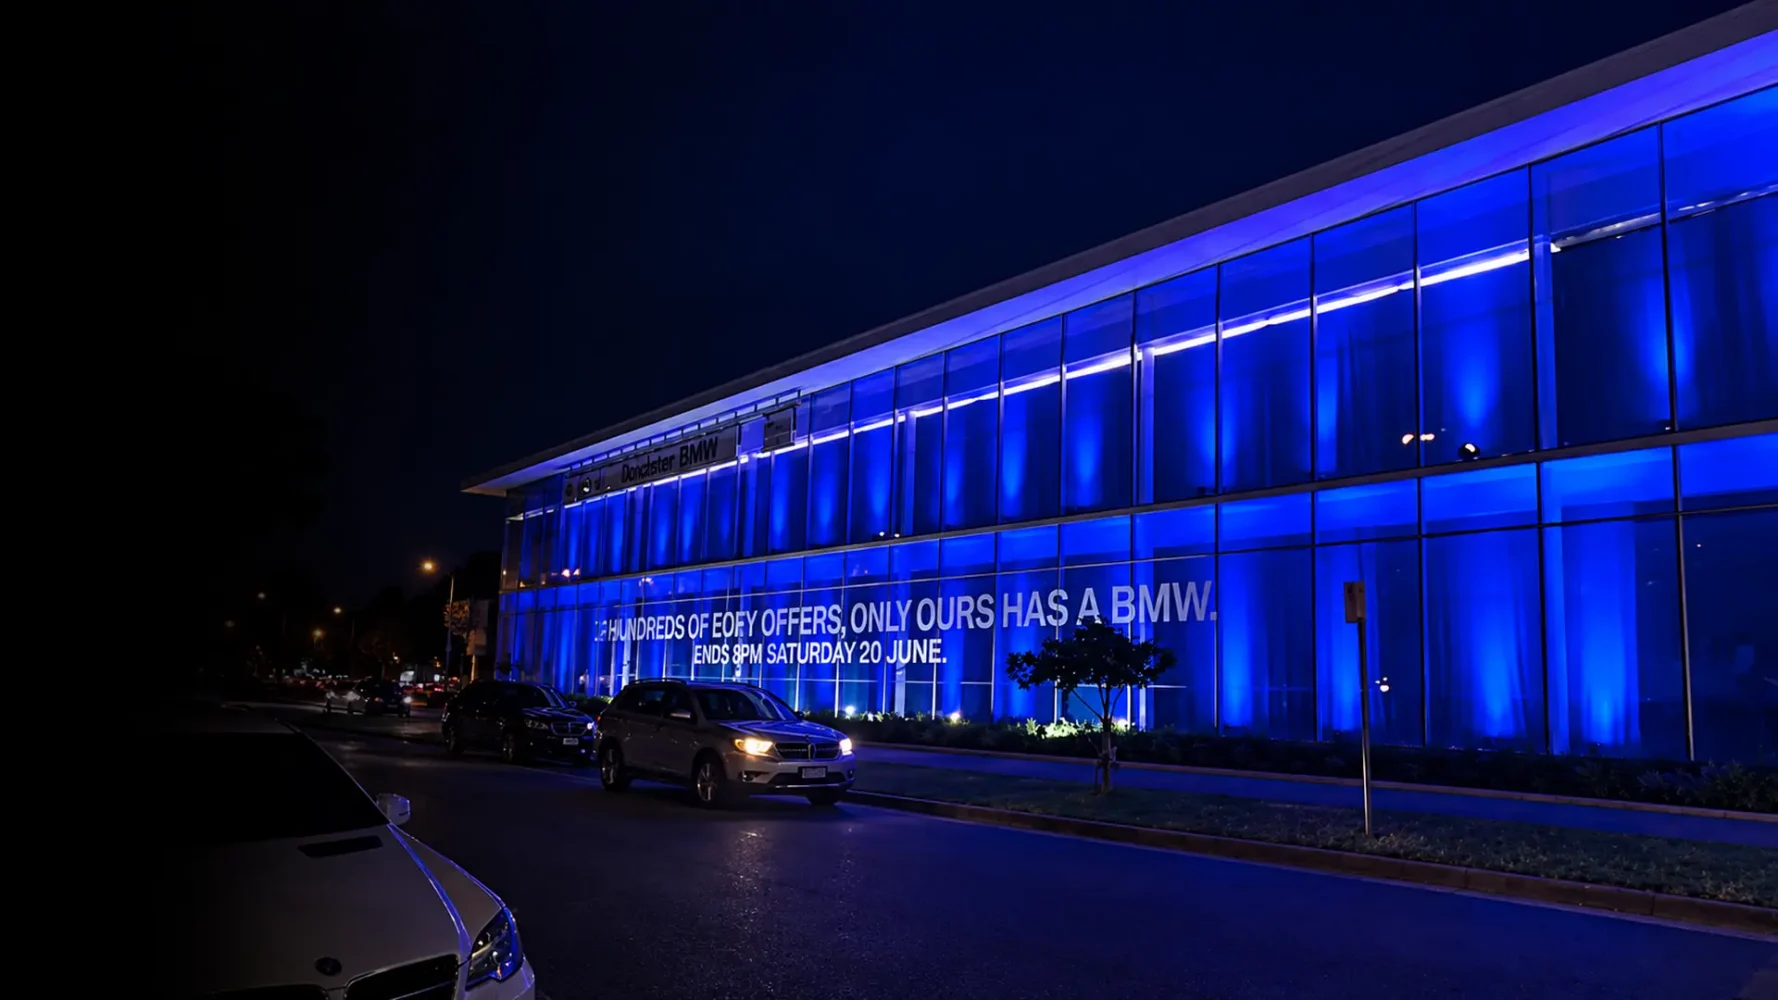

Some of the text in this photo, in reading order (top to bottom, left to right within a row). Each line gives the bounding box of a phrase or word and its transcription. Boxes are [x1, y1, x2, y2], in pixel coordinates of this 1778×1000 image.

[680, 437, 718, 466] BMW
[608, 615, 684, 641] HUNDREDS
[688, 614, 709, 639] OF
[712, 611, 757, 637] EOFY
[762, 606, 845, 637] OFFERS,
[850, 601, 912, 633] ONLY
[916, 594, 995, 631] OURS
[1003, 590, 1068, 627] HAS
[1076, 588, 1103, 625] A
[1112, 581, 1217, 622] BMW.
[694, 639, 947, 664] ENDS 8PM SATURDAY 20 JUNE.
